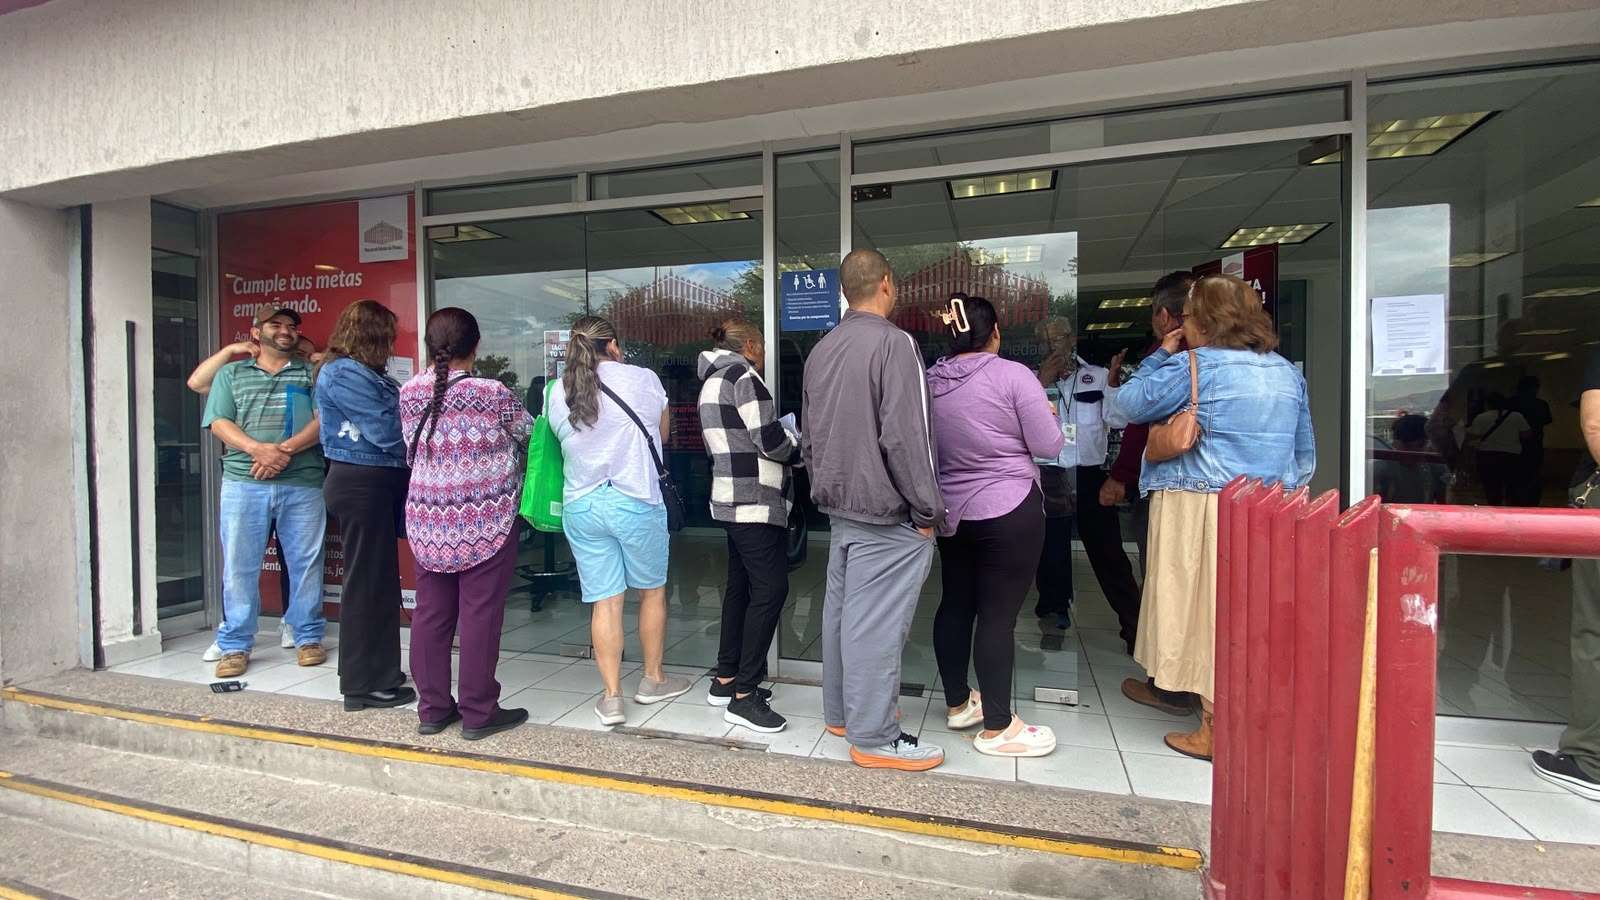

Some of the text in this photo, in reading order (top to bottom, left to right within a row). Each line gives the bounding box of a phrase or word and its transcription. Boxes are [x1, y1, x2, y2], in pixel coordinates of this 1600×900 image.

[233, 270, 363, 296] Cumple tus metas
[233, 294, 321, 317] emando.
